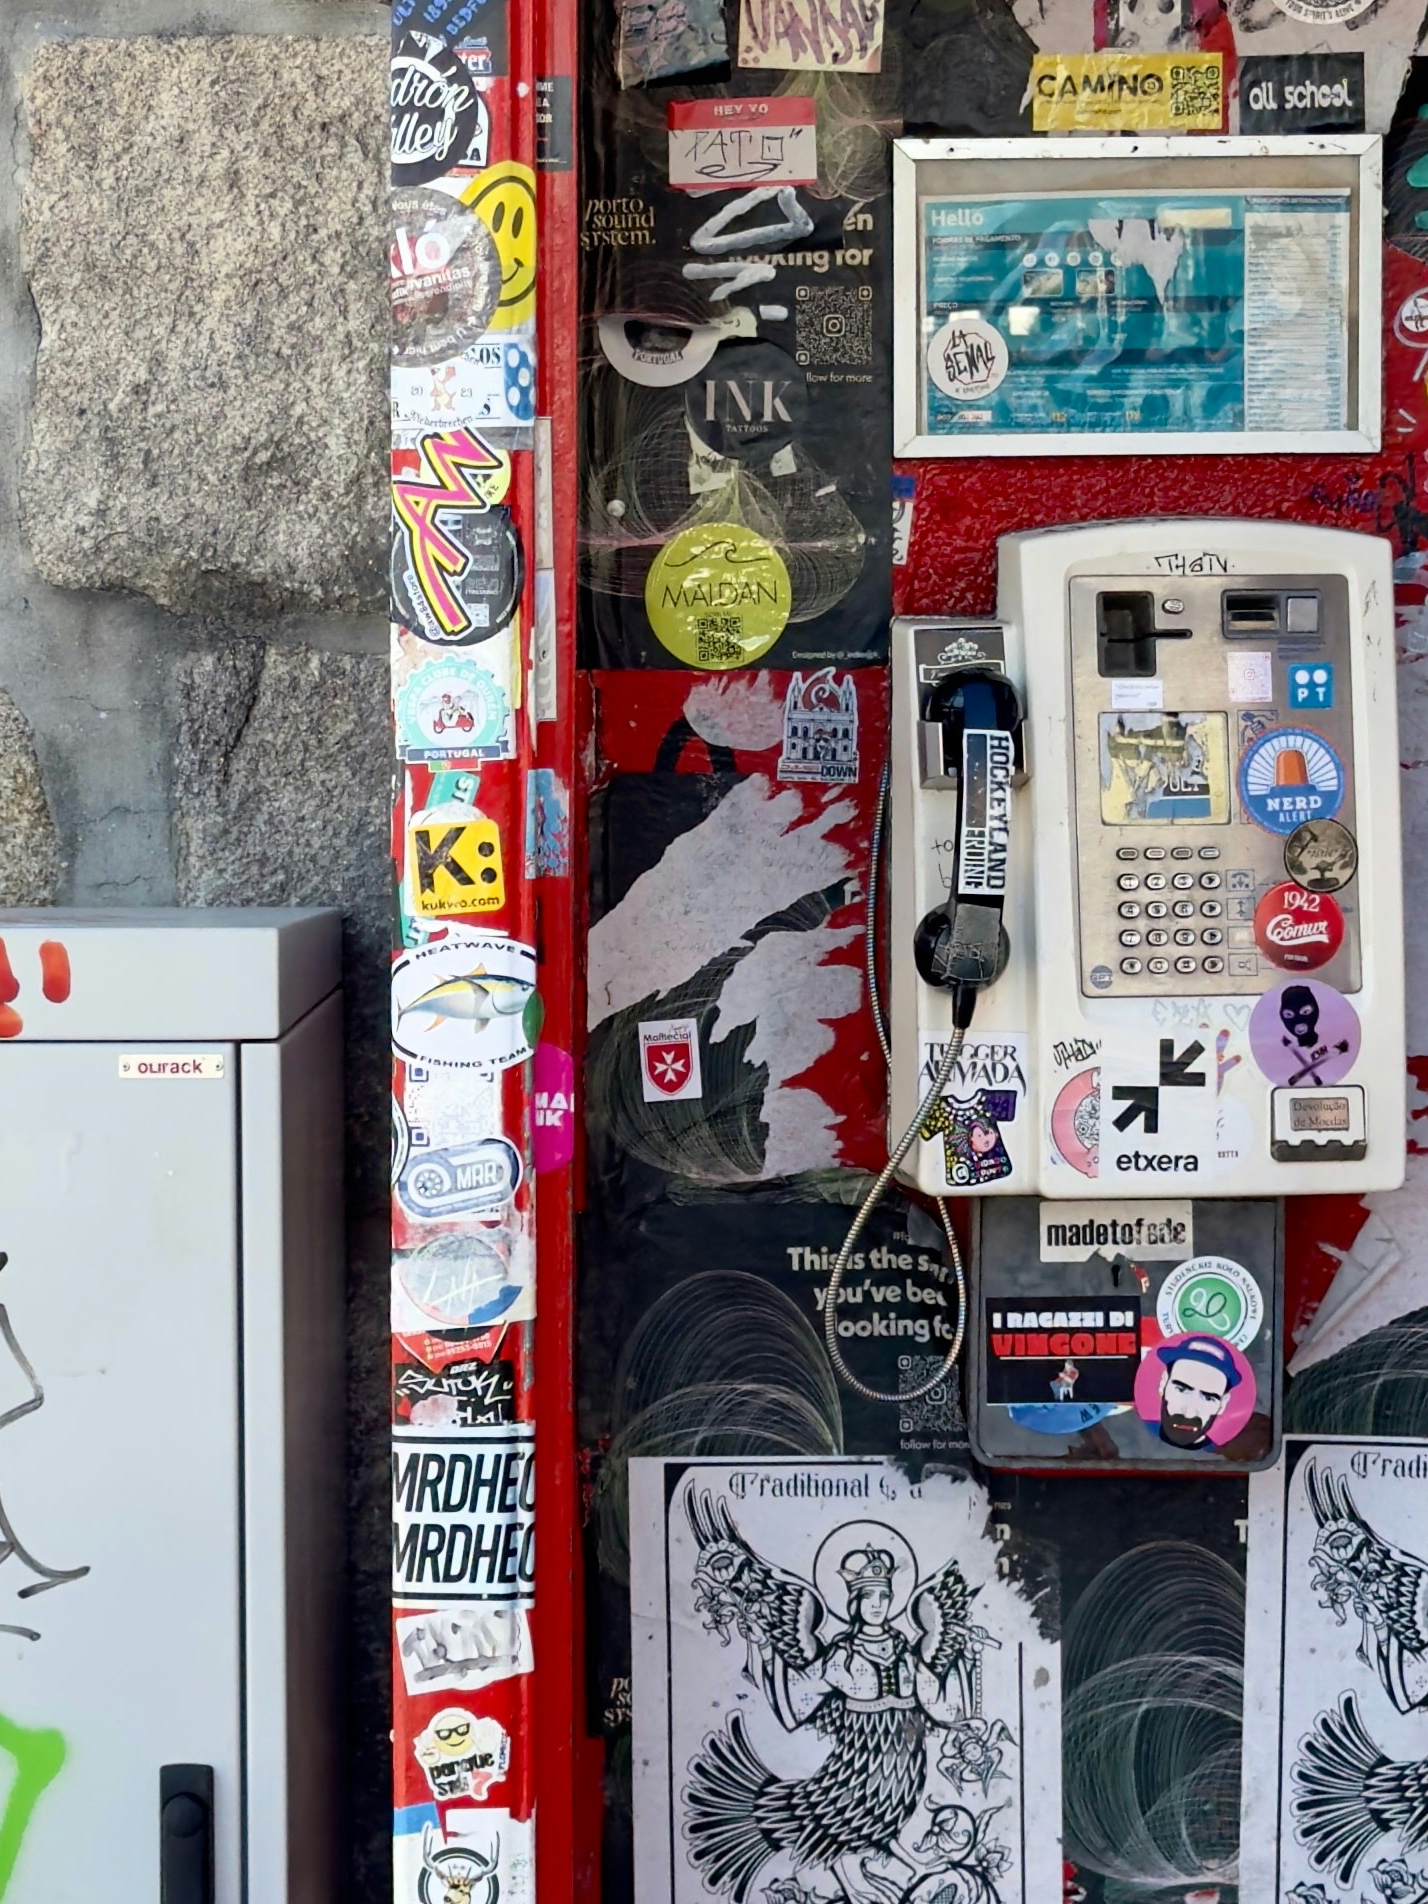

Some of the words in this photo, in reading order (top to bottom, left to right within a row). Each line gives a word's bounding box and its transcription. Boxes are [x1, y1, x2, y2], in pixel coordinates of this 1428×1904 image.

[1036, 72, 1164, 98] CAMINO
[1283, 75, 1354, 111] school
[713, 104, 742, 117] HEY
[748, 103, 770, 116] YO
[584, 194, 645, 220] porto
[930, 207, 985, 228] Hello
[590, 208, 655, 228] sound
[633, 348, 682, 364] PORTUGAL
[705, 379, 793, 424] INK
[724, 423, 770, 434] TATTOOS
[423, 748, 485, 760] PORTUGAL
[820, 765, 859, 779] DOWN
[985, 734, 1011, 890] HOCKEYLAND
[1266, 795, 1323, 812] NERD
[1278, 809, 1313, 824] ALERT
[1282, 889, 1321, 914] 1942
[414, 941, 517, 962] HEATWAVE
[419, 1054, 484, 1070] FISHING
[486, 1045, 528, 1066] TEAM
[1293, 1100, 1350, 1113] Devolução
[1293, 1116, 1307, 1129] de
[1307, 1115, 1349, 1129] Moedas
[1115, 1151, 1199, 1173] etxera
[871, 1244, 914, 1272] the
[992, 1312, 1002, 1329] I
[1010, 1311, 1106, 1329] RAGAZZI
[1109, 1311, 1134, 1329] DI
[990, 1332, 1137, 1356] VINGONE
[899, 1438, 935, 1451] follow
[728, 1472, 869, 1500] Traditional
